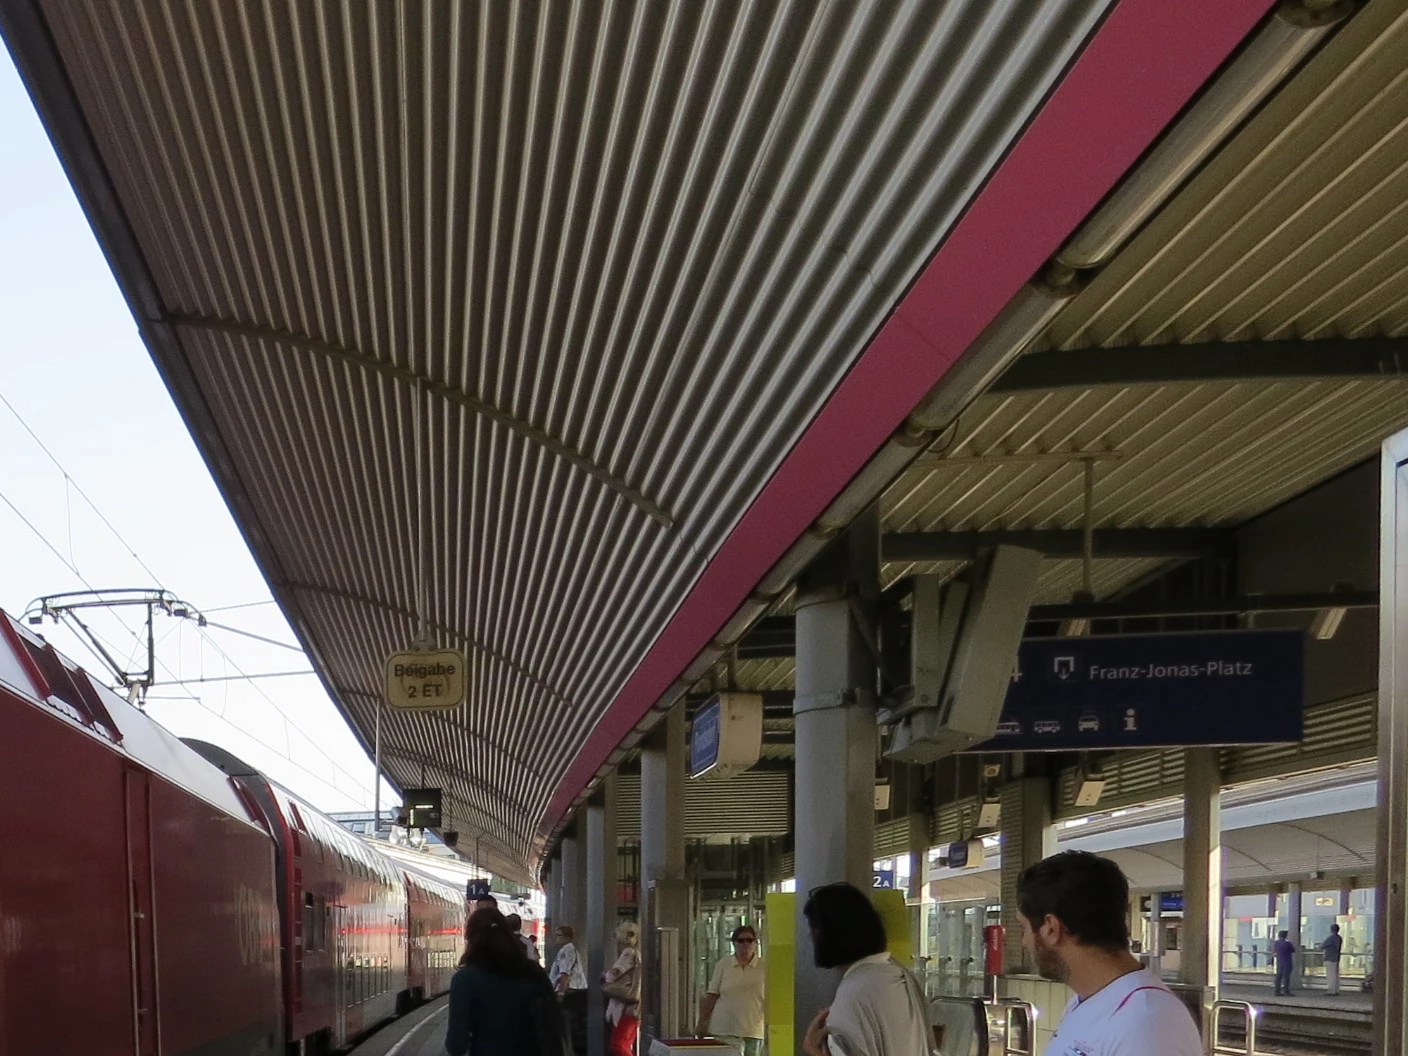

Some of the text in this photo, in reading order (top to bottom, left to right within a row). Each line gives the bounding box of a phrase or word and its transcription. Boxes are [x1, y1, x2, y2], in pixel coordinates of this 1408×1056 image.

[394, 663, 456, 679] Beigabe
[1089, 660, 1253, 680] Franz-Jonas-Platz
[408, 684, 443, 698] 2 ET
[873, 876, 890, 888] 2A
